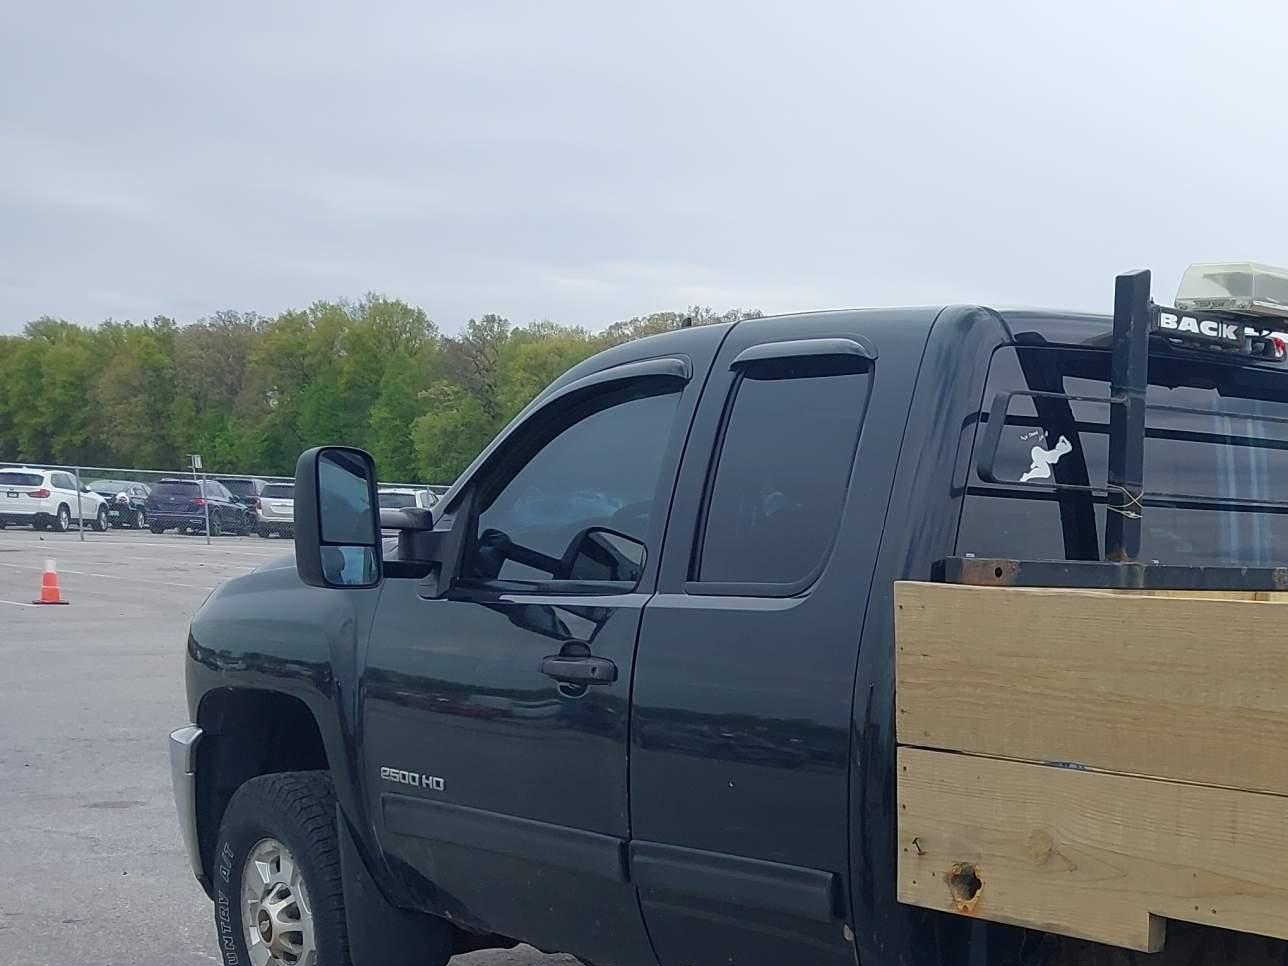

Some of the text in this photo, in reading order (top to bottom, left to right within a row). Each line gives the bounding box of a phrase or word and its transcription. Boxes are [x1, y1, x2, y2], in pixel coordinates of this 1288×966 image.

[1160, 312, 1238, 340] BACK
[380, 766, 445, 791] 2500 HD
